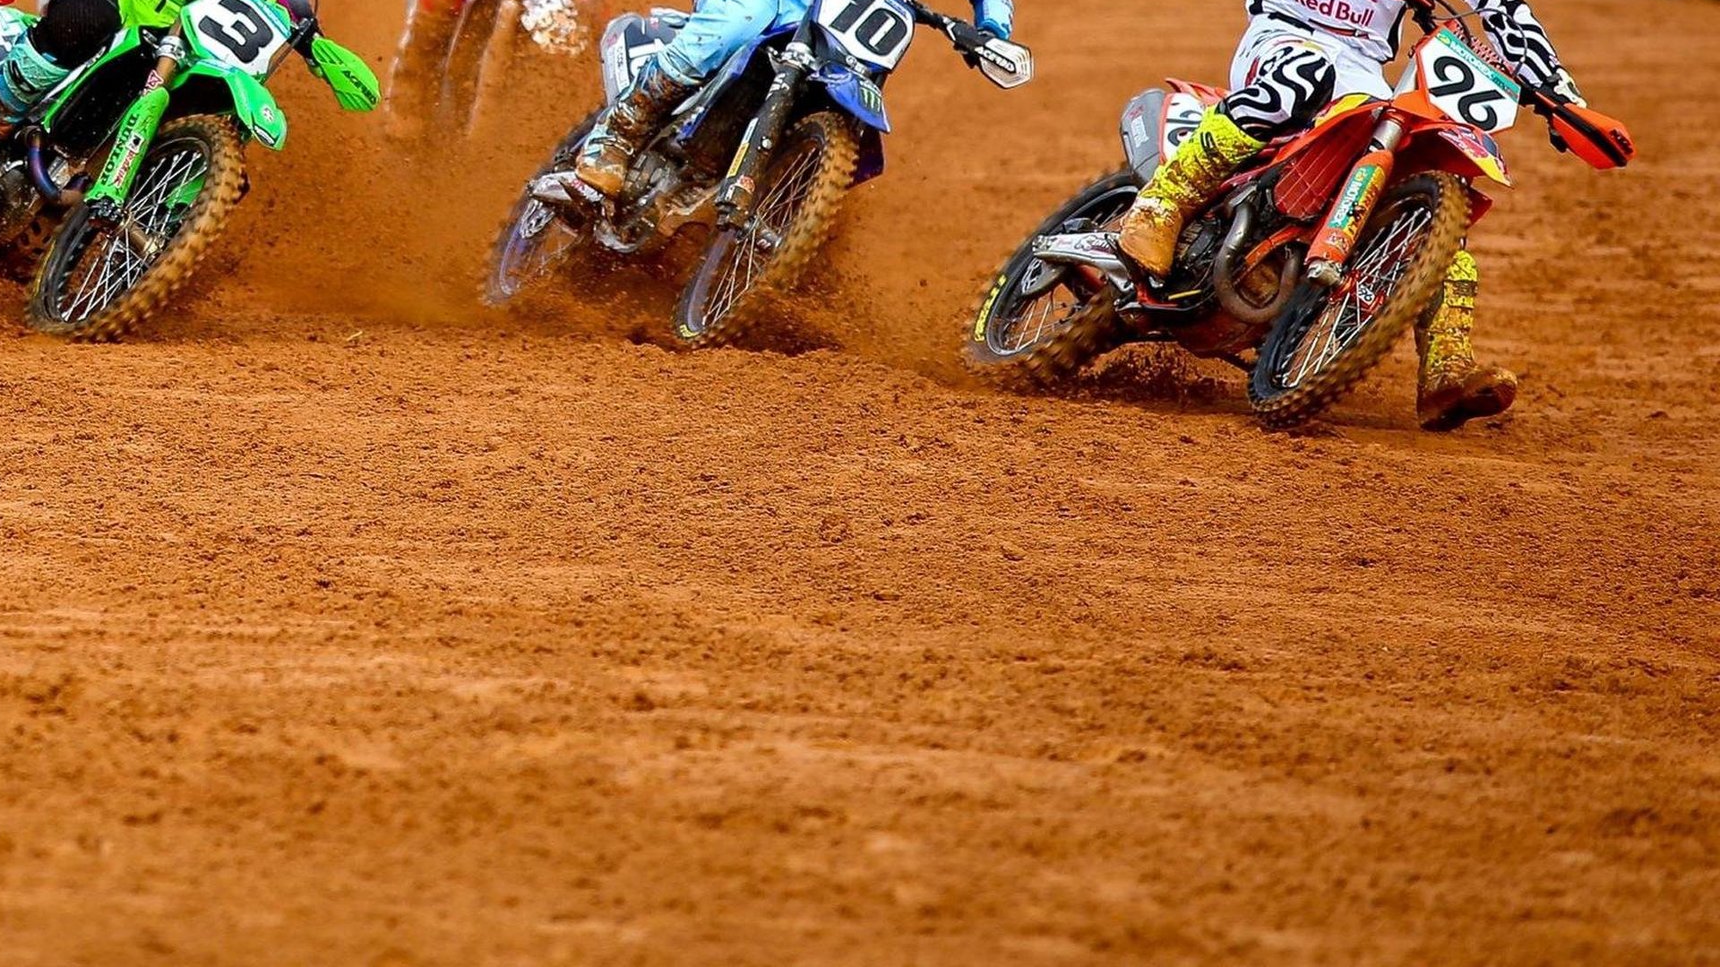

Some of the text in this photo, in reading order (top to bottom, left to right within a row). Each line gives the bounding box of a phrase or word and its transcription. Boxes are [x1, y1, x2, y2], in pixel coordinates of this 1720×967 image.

[974, 47, 1017, 74] ACERBIS
[1429, 55, 1506, 132] 96
[100, 113, 140, 186] DUNLOP
